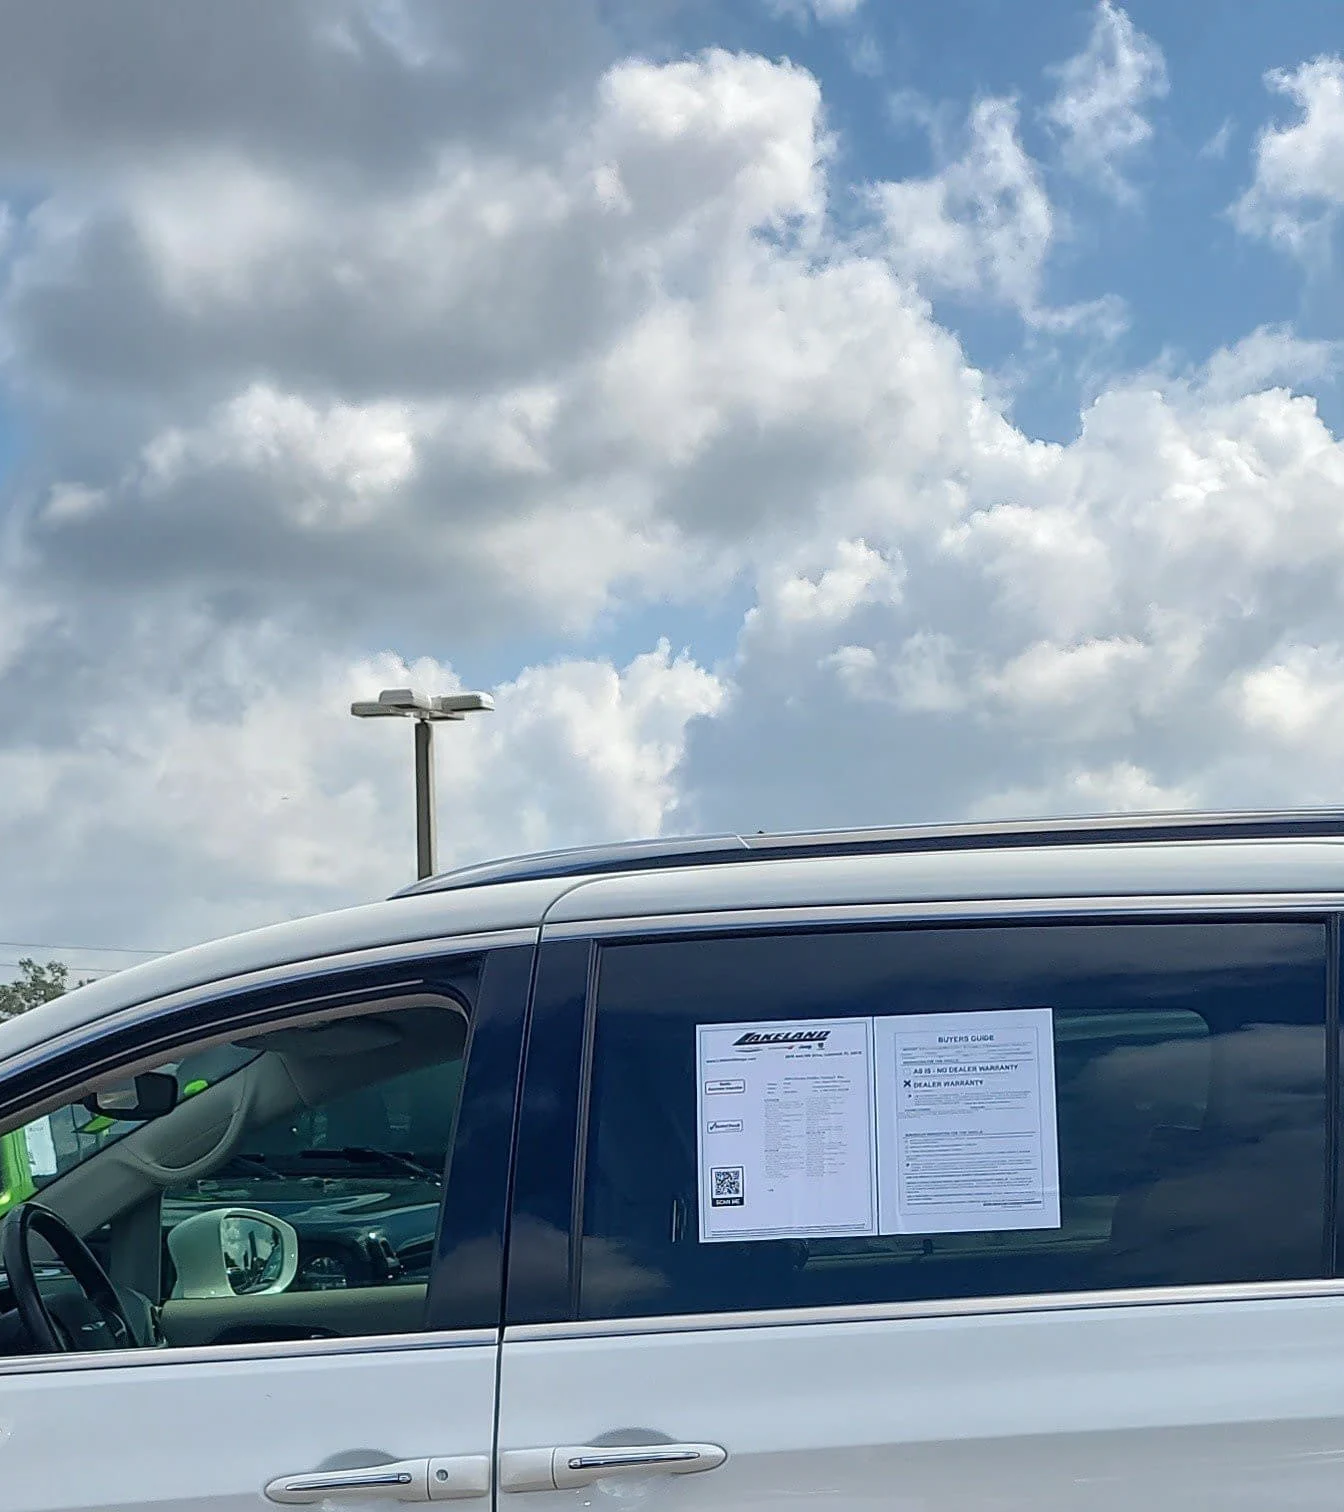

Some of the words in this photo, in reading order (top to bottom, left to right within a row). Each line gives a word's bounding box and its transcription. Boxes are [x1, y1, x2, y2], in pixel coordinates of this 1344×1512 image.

[732, 1031, 831, 1046] LAKELAND
[971, 1034, 994, 1042] GUIDE
[913, 1067, 922, 1075] AS
[936, 1066, 947, 1074] NO
[949, 1065, 977, 1073] DEALER
[978, 1064, 1018, 1072] WARRANTY
[913, 1081, 942, 1089] DEALER
[943, 1080, 984, 1088] WARRANTY
